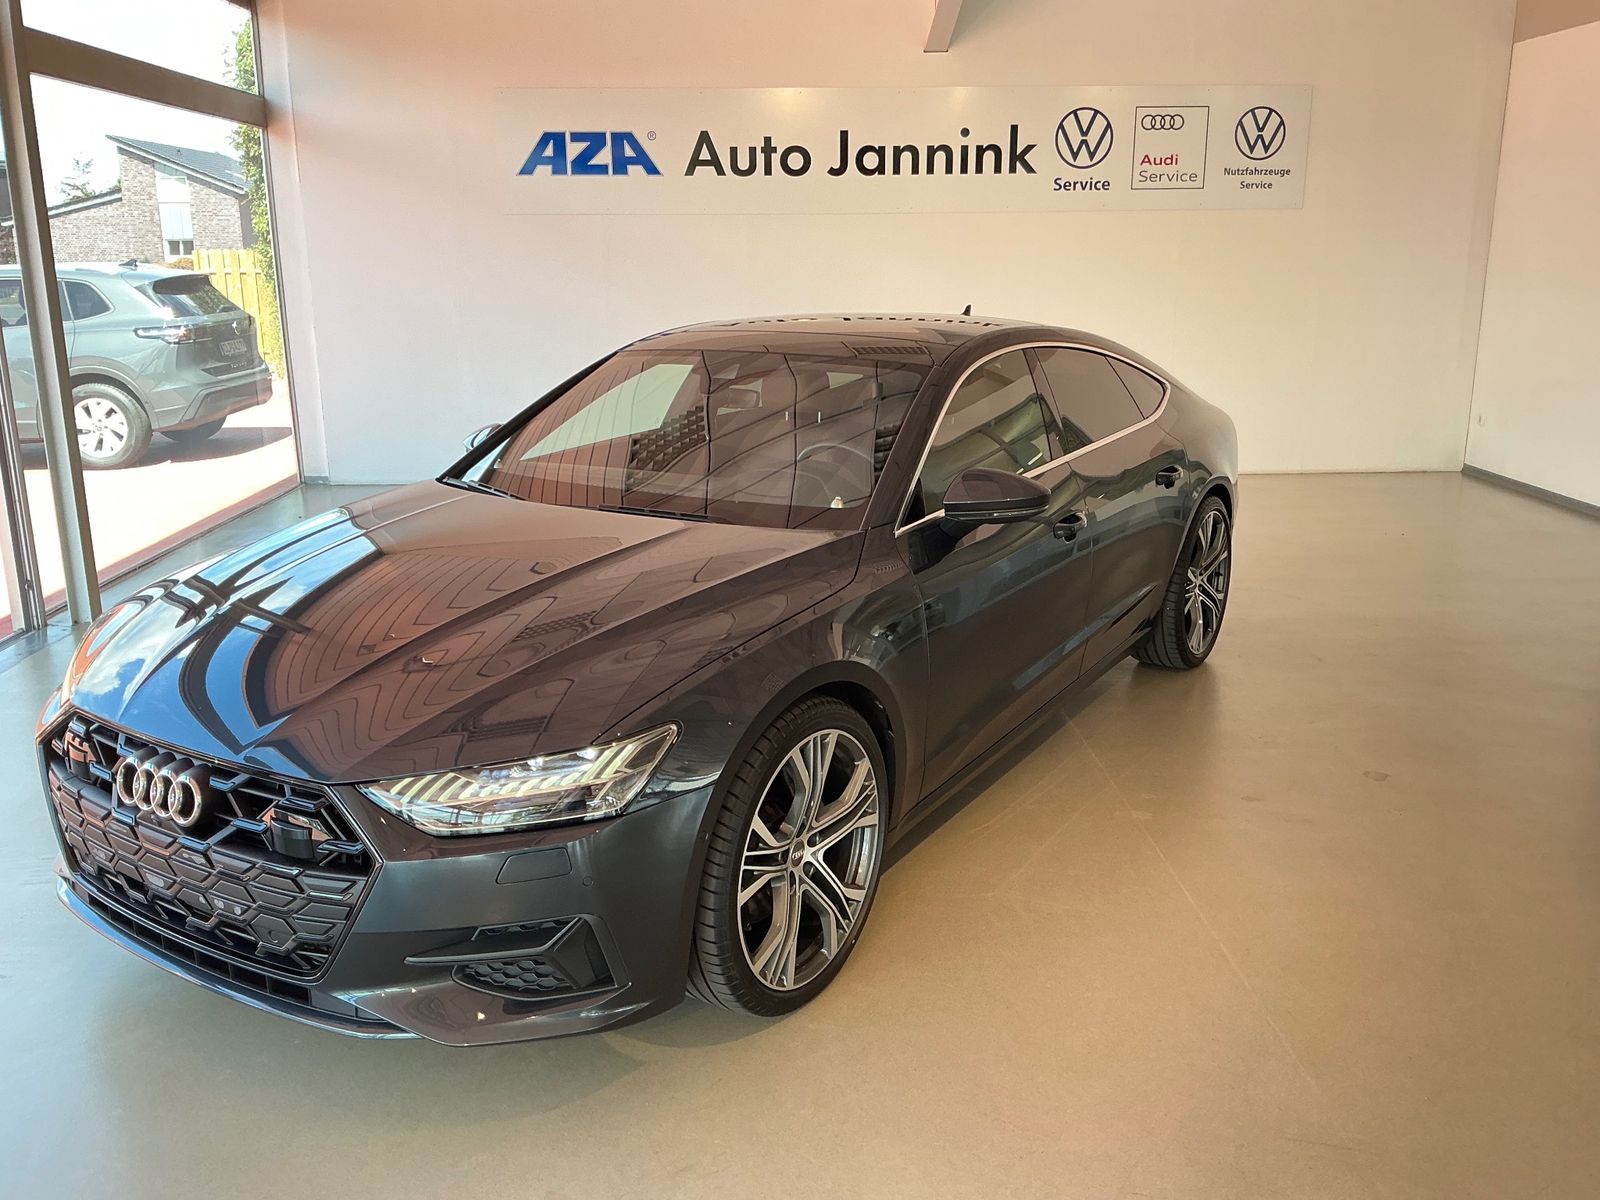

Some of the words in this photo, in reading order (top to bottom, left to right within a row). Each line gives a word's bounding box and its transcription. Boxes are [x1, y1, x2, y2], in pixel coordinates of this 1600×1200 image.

[683, 130, 812, 177] Auto
[826, 123, 1038, 177] Jannink
[1140, 153, 1179, 166] Audi
[1138, 169, 1198, 183] Service
[1223, 166, 1291, 178] Nutzfahrzeuge
[1053, 177, 1111, 192] Service
[1239, 180, 1273, 190] Service
